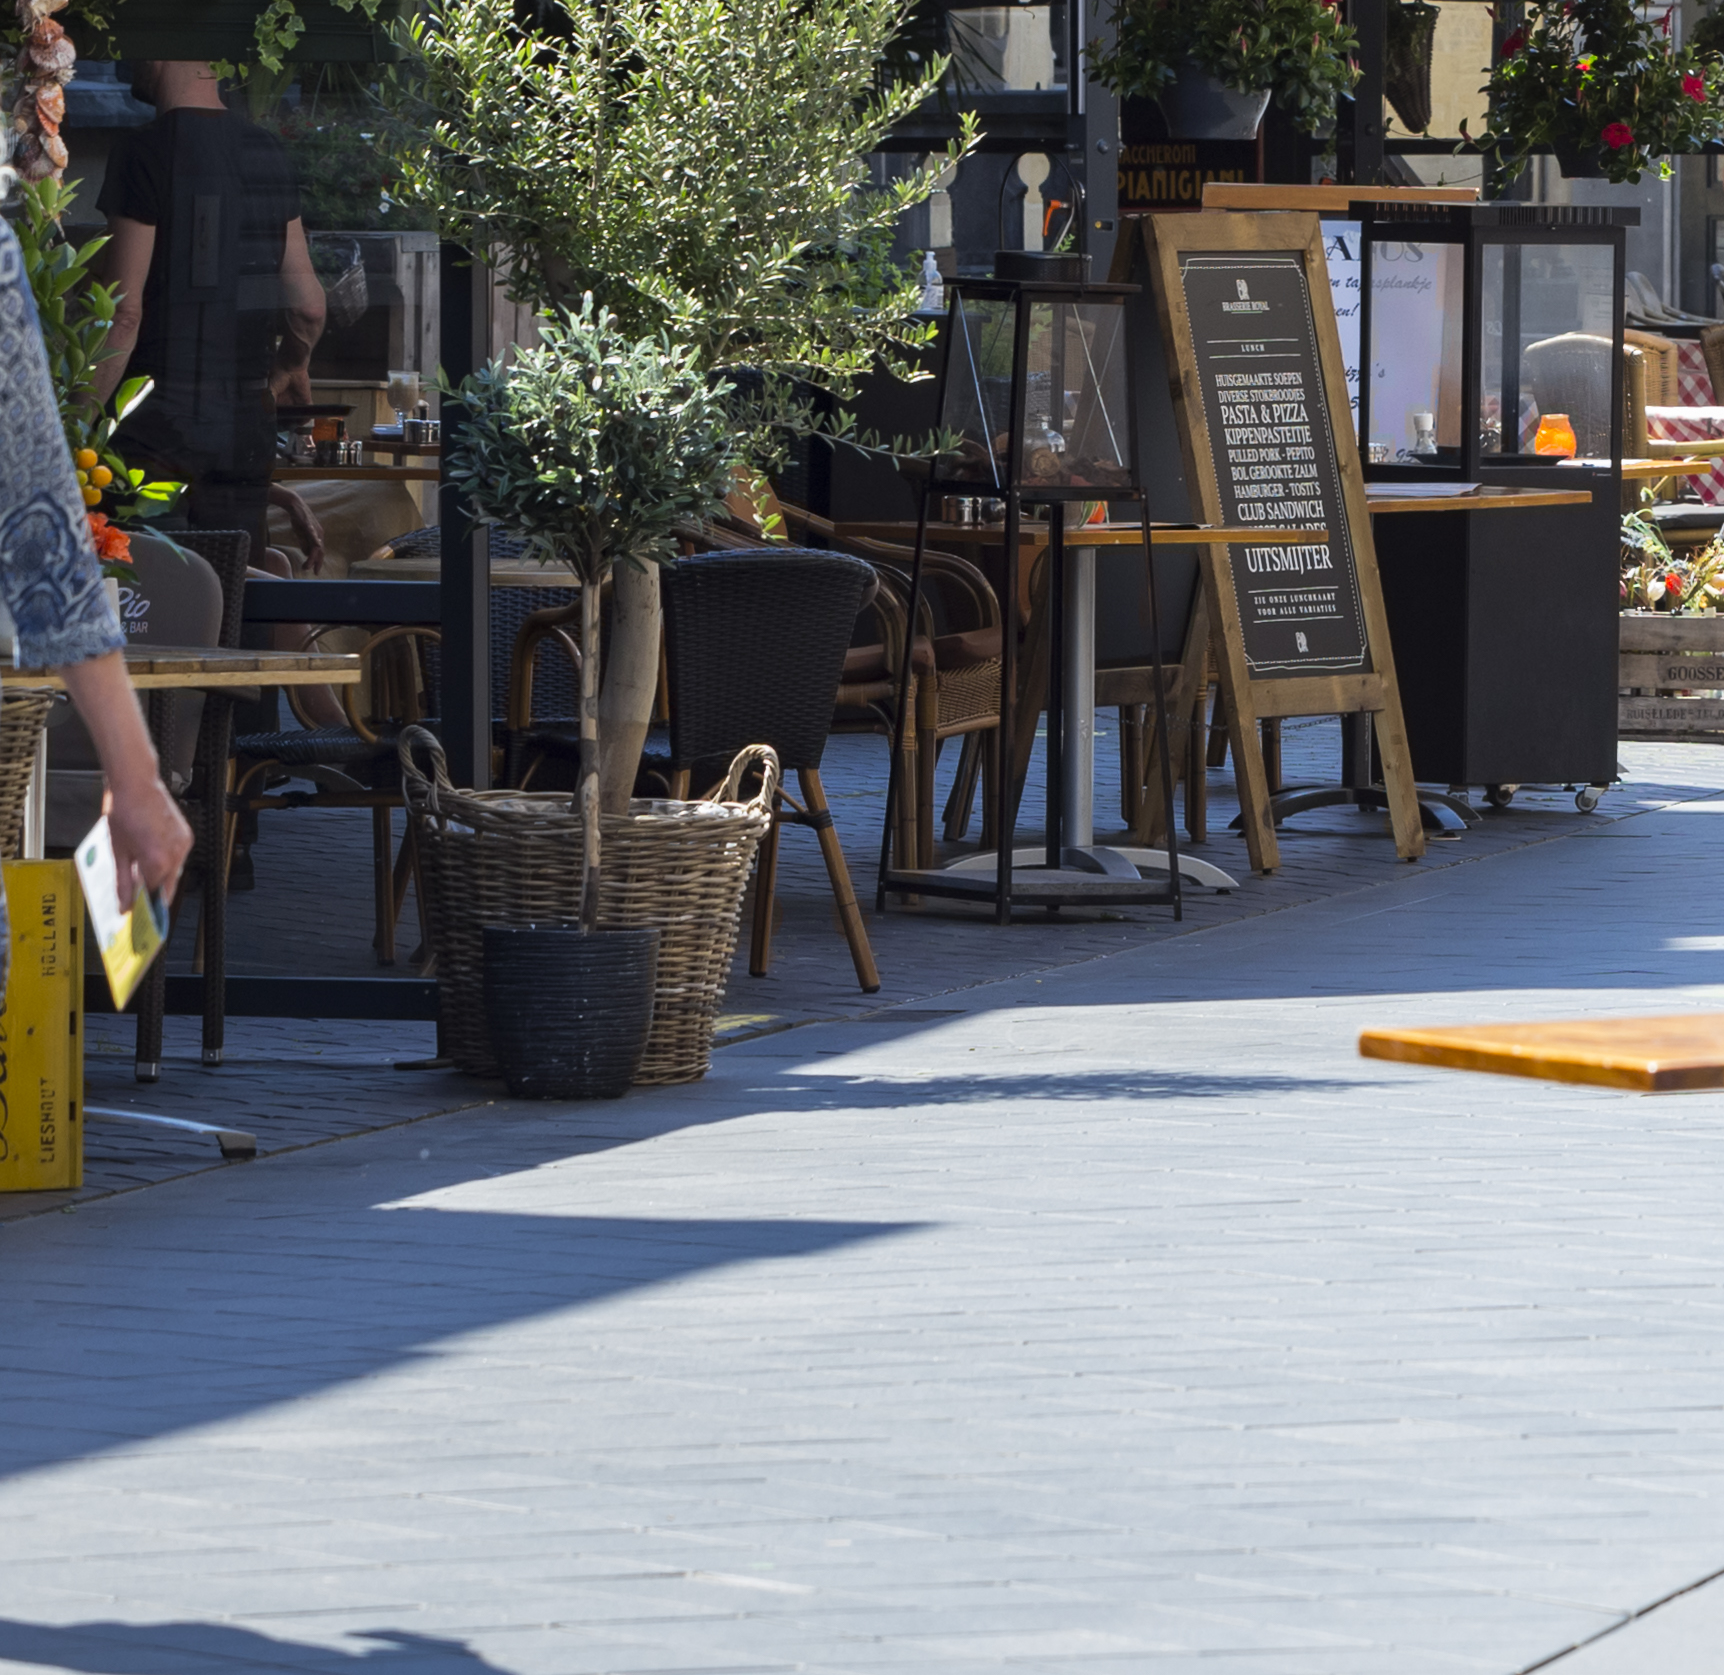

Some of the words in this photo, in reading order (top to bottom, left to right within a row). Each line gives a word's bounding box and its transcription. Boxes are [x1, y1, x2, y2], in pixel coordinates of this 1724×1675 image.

[1119, 144, 1196, 164] ACCHERONI
[1241, 344, 1265, 352] LUNCH
[1215, 373, 1273, 387] HUISGEMAAKTE
[1273, 372, 1303, 386] SOEPEN
[1218, 390, 1249, 403] DIVERSE
[1249, 388, 1306, 402] STOKBROODJES
[1220, 405, 1259, 425] PASTA
[1261, 404, 1272, 424] &
[1272, 403, 1309, 423] PIZZA
[1224, 426, 1313, 445] KIPPENPASTEITJE
[1228, 449, 1258, 462] PULLED
[1259, 448, 1281, 461] PORK
[1286, 446, 1315, 460] PEPITO
[1231, 466, 1249, 481] BOL
[1249, 465, 1293, 480] GEROOKTE
[1293, 463, 1318, 478] ZALM
[1234, 484, 1285, 499] HAMBURGER
[1237, 502, 1266, 521] CLUB
[1266, 500, 1325, 520] SANDWICH
[1244, 544, 1333, 575] UITSMIJTER
[1254, 596, 1267, 605] ZIE
[1269, 595, 1288, 604] ONZE
[1290, 592, 1336, 603] LUNCHKAART
[1257, 606, 1277, 616] VOOR
[1280, 606, 1297, 615] ALLE
[1299, 604, 1337, 614] VARIATIES
[129, 621, 148, 634] BAR
[41, 892, 57, 978] HOLLAND
[39, 1076, 56, 1163] LIESHOUT
